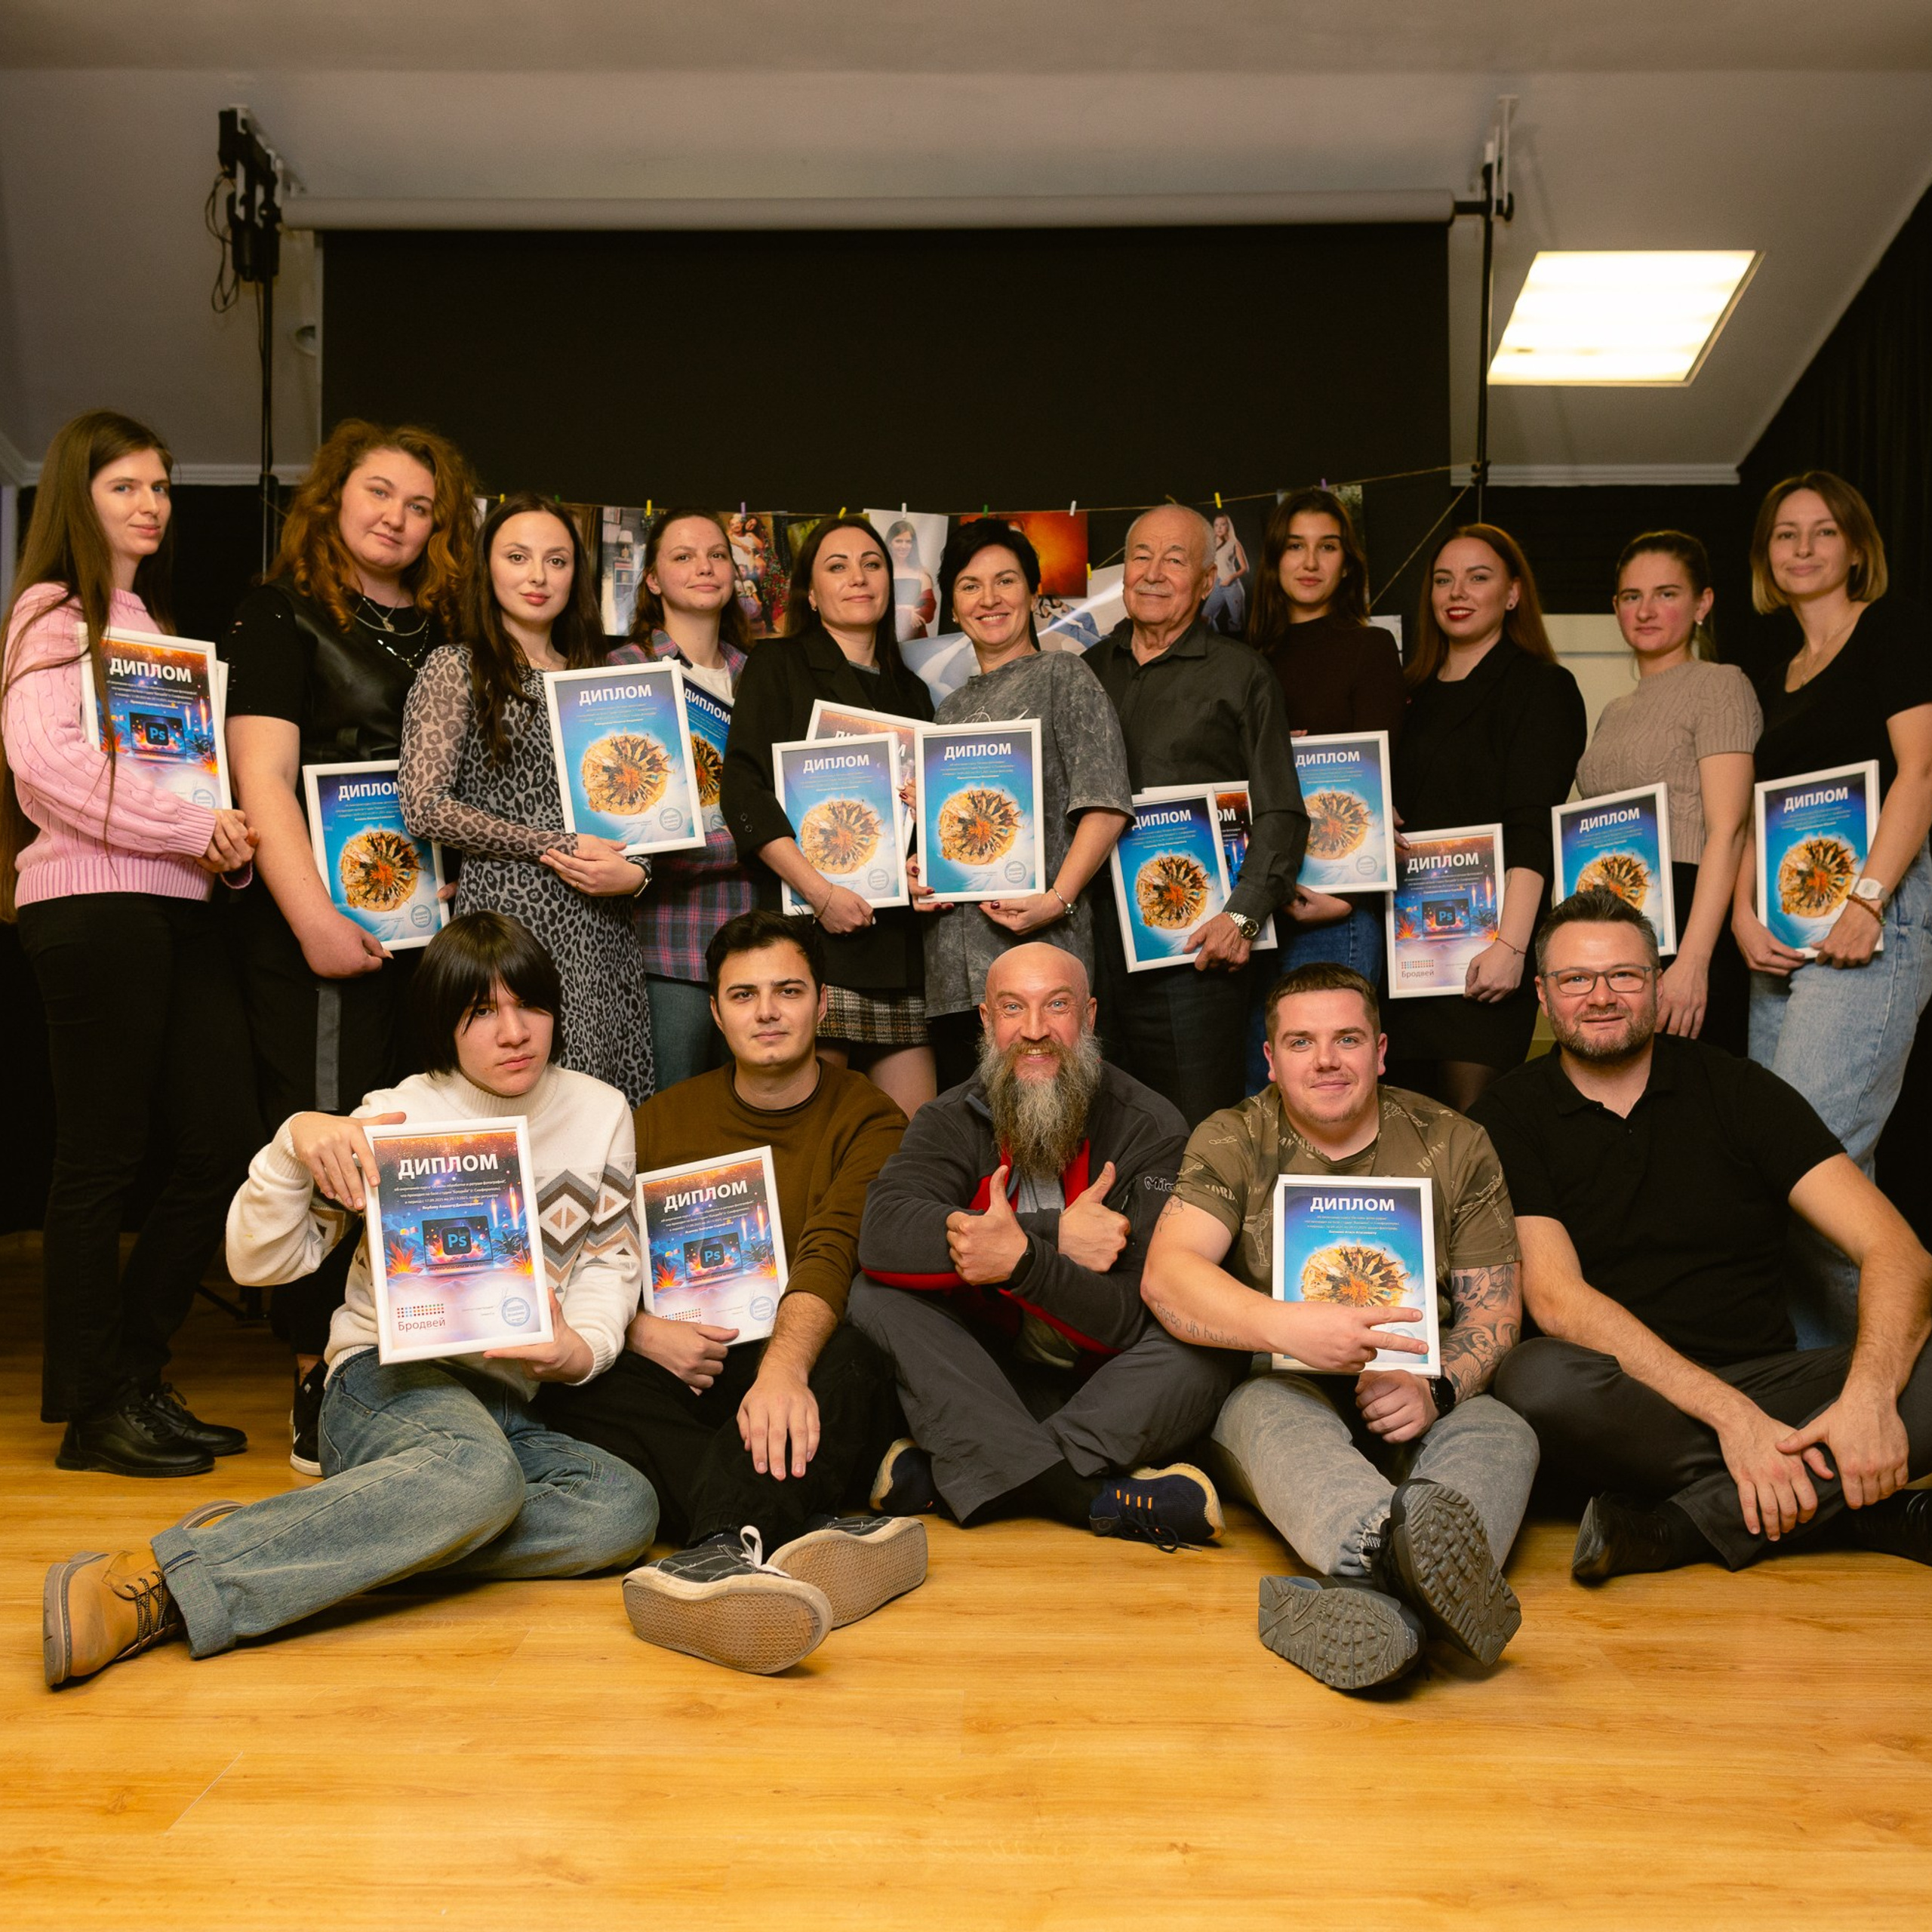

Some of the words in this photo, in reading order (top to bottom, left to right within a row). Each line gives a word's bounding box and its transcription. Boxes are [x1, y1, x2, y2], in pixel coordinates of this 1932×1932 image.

[109, 657, 192, 683] ДИПЛОМ
[579, 684, 652, 706] ДИПЛОМ
[685, 688, 731, 725] ДИПЛОМ
[149, 727, 166, 741] Ps
[944, 743, 1011, 761] ДИПЛОМ
[1295, 750, 1361, 768] ДИПЛОМ
[803, 754, 870, 774] ДИПЛОМ
[1783, 786, 1848, 814] ДИПЛОМ
[1132, 809, 1192, 831] ДИПЛОМ
[1579, 808, 1640, 834] ДИПЛОМ
[1407, 852, 1479, 874] ДИПЛОМ
[1438, 911, 1453, 922] Ps
[1401, 971, 1434, 980] Бродвей
[398, 1153, 499, 1180] ДИПЛОМ
[664, 1180, 748, 1214] ДИПЛОМ
[1309, 1196, 1395, 1213] ДИПЛОМ
[448, 1234, 467, 1248] Ps
[704, 1250, 721, 1263] Ps
[398, 1318, 446, 1333] Бродвей
